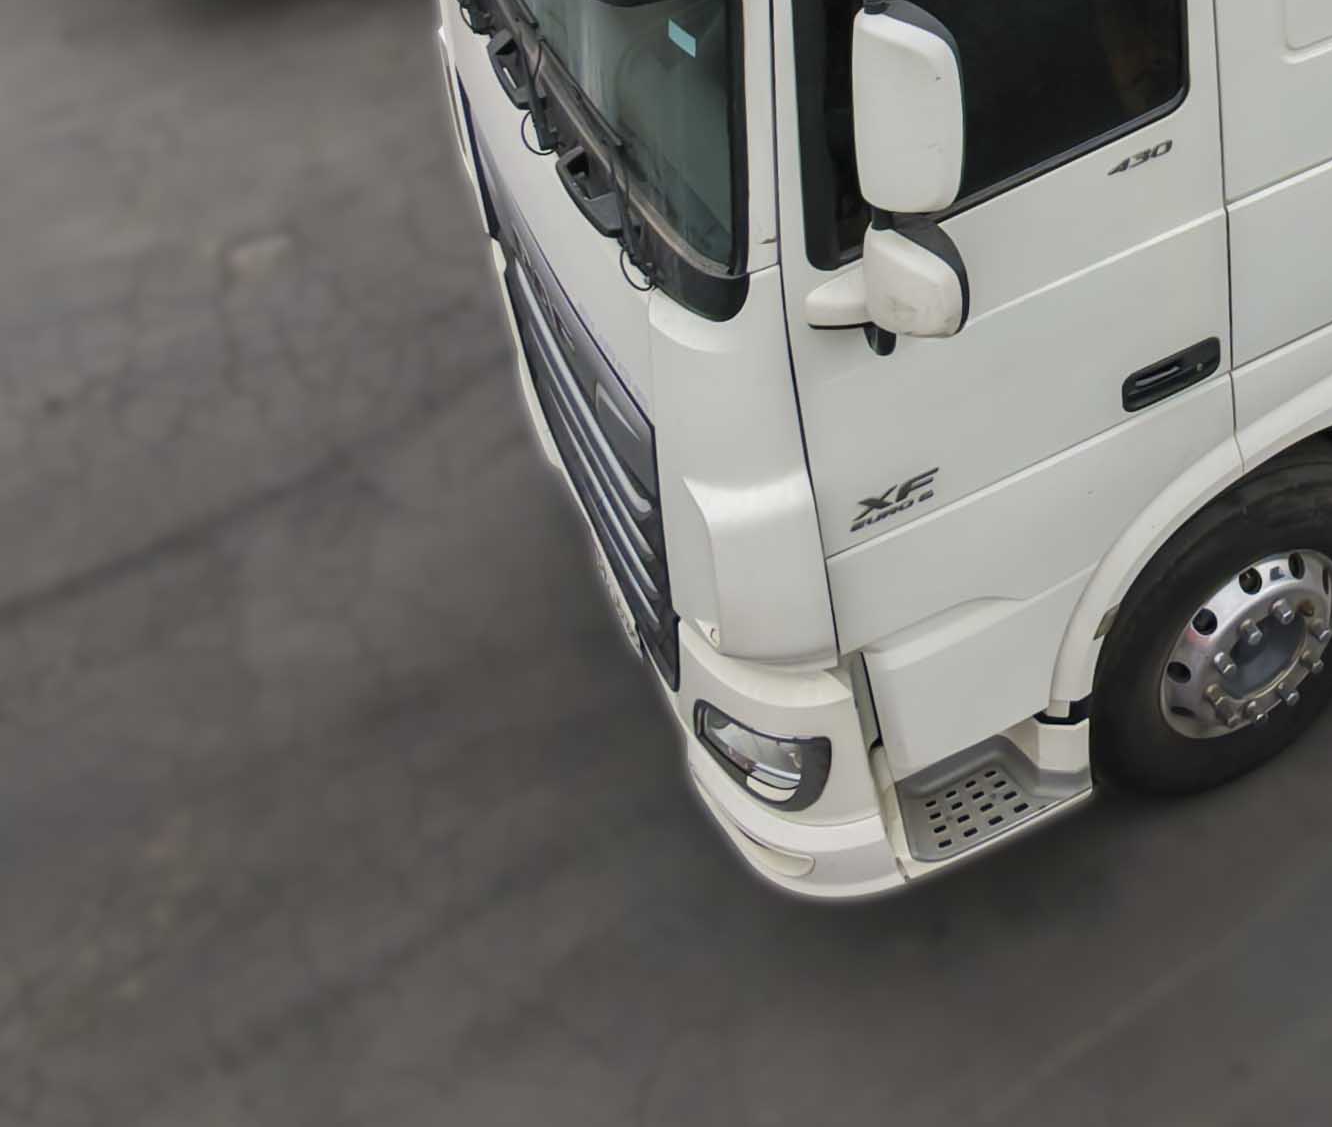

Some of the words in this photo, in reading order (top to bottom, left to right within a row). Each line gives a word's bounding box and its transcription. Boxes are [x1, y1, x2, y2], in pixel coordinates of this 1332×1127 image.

[1107, 139, 1173, 176] 430
[852, 466, 940, 522] XF
[849, 498, 914, 533] EURO
